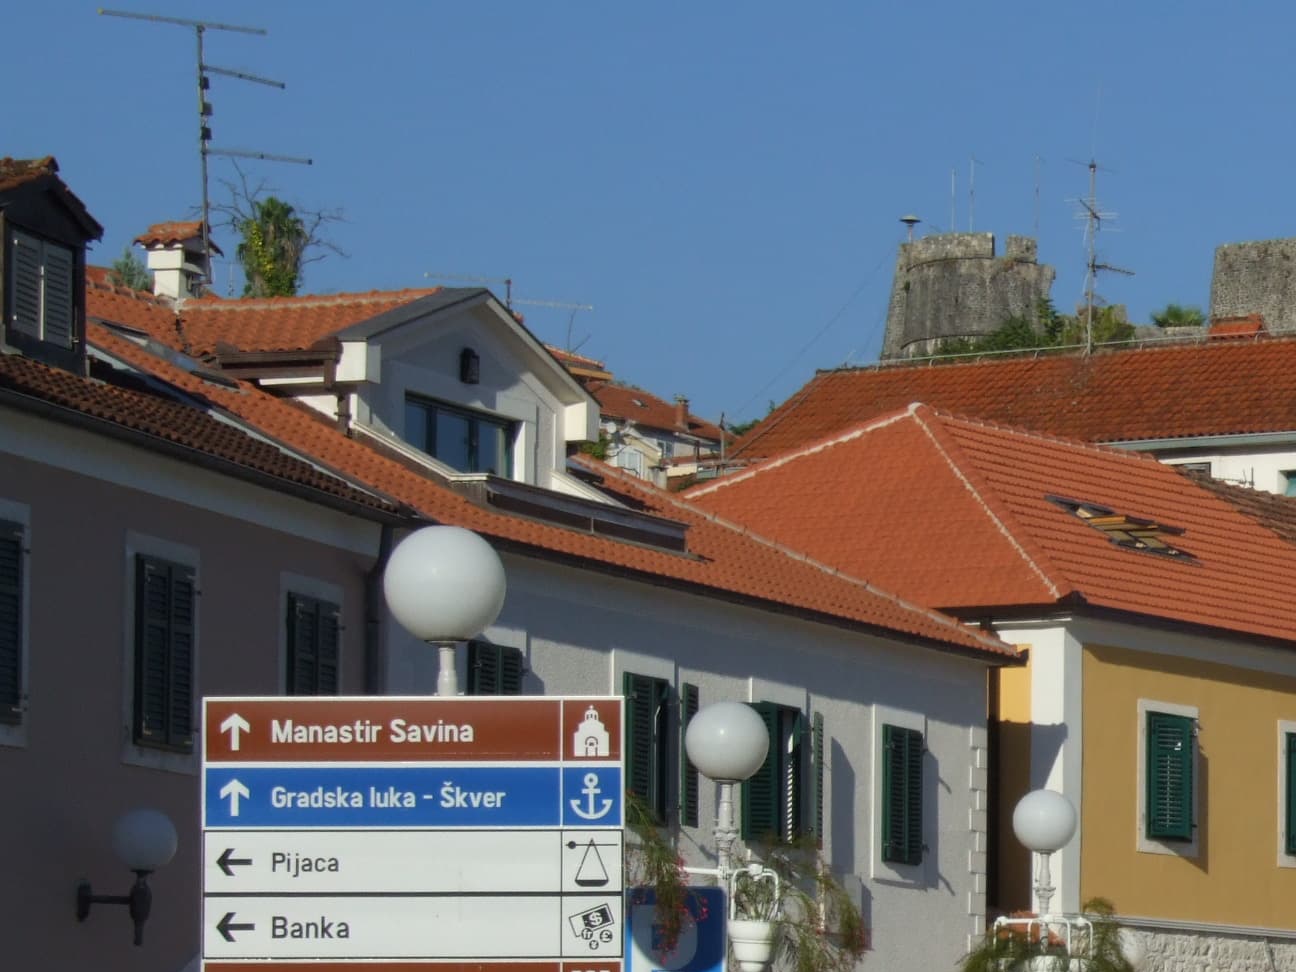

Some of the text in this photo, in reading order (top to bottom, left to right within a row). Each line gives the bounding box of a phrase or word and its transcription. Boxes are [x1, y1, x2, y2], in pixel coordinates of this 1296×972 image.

[271, 718, 475, 744] Manastir Savina
[271, 786, 363, 809] Gradska
[369, 786, 417, 809] luka
[440, 781, 507, 809] Škver
[271, 852, 340, 878] Pijaca
[271, 916, 350, 940] Banka
